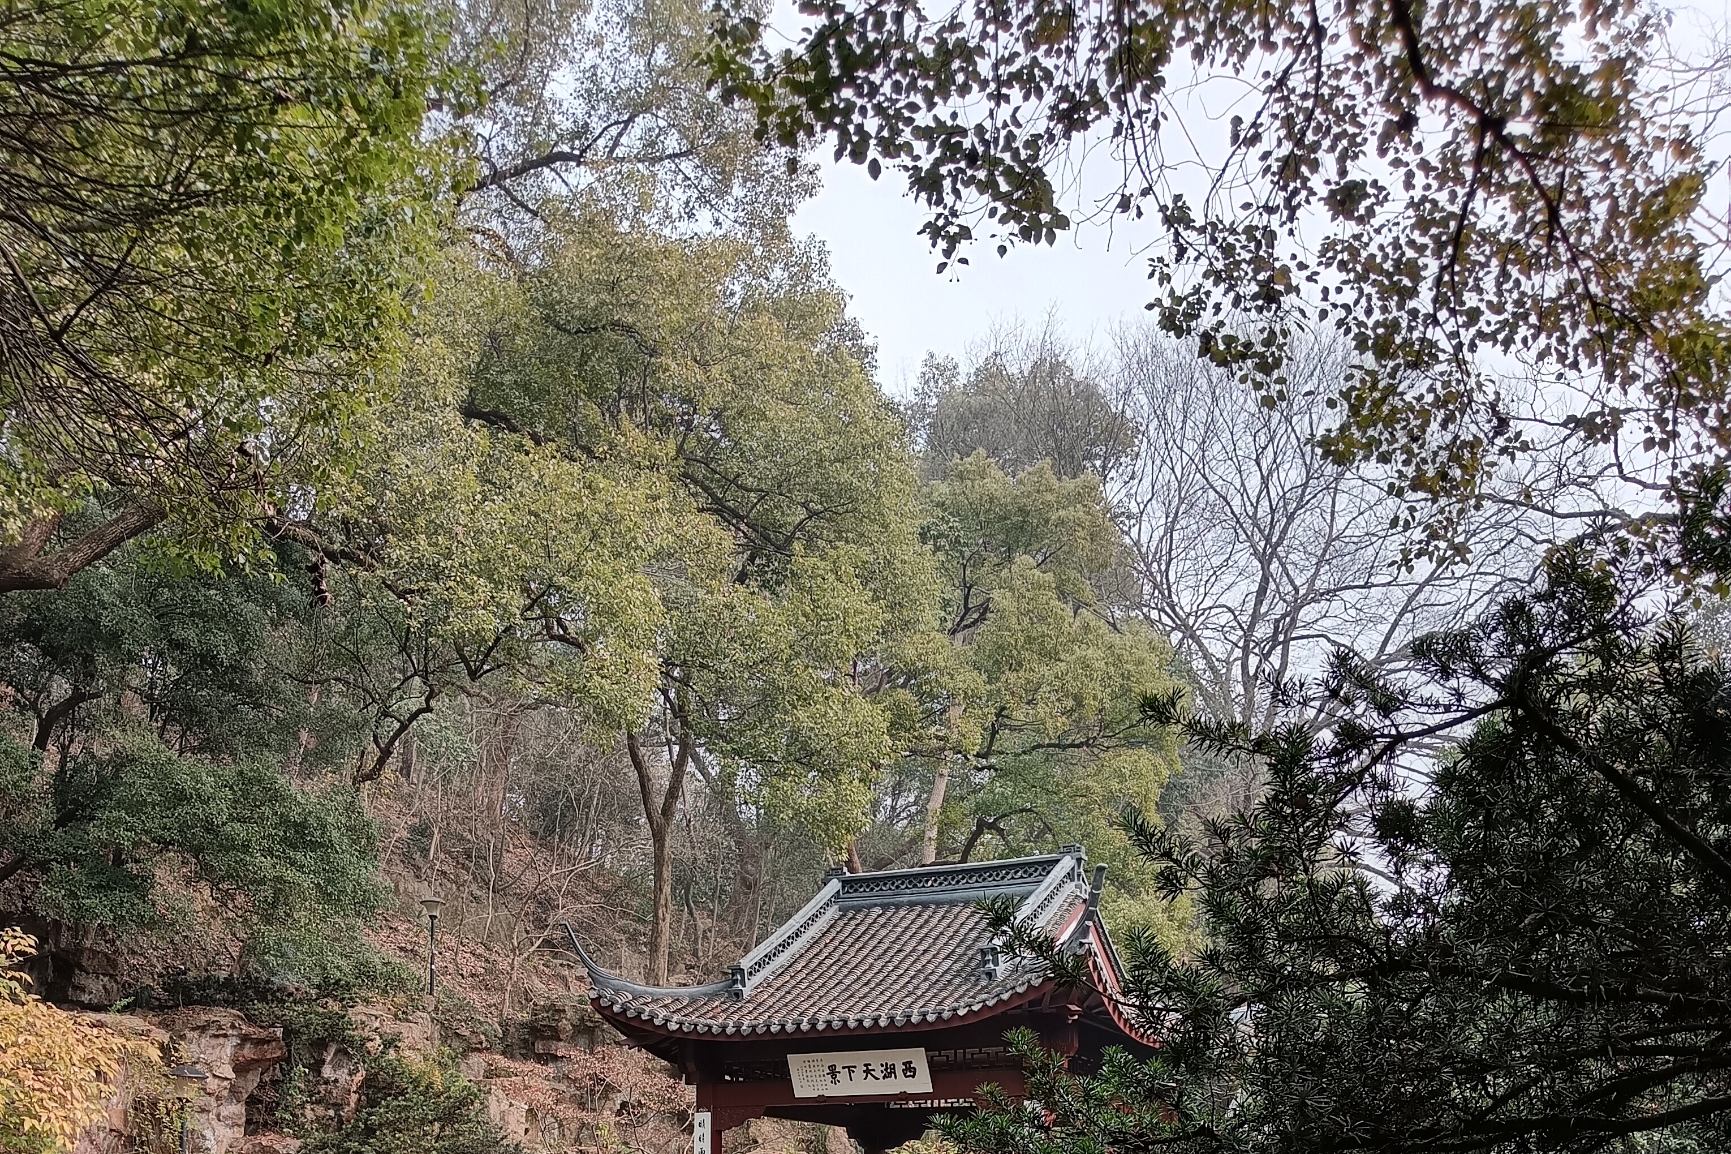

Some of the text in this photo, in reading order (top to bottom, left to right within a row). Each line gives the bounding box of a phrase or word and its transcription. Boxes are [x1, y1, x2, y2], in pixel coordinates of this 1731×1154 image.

[825, 1060, 917, 1086] 西湖天下景
